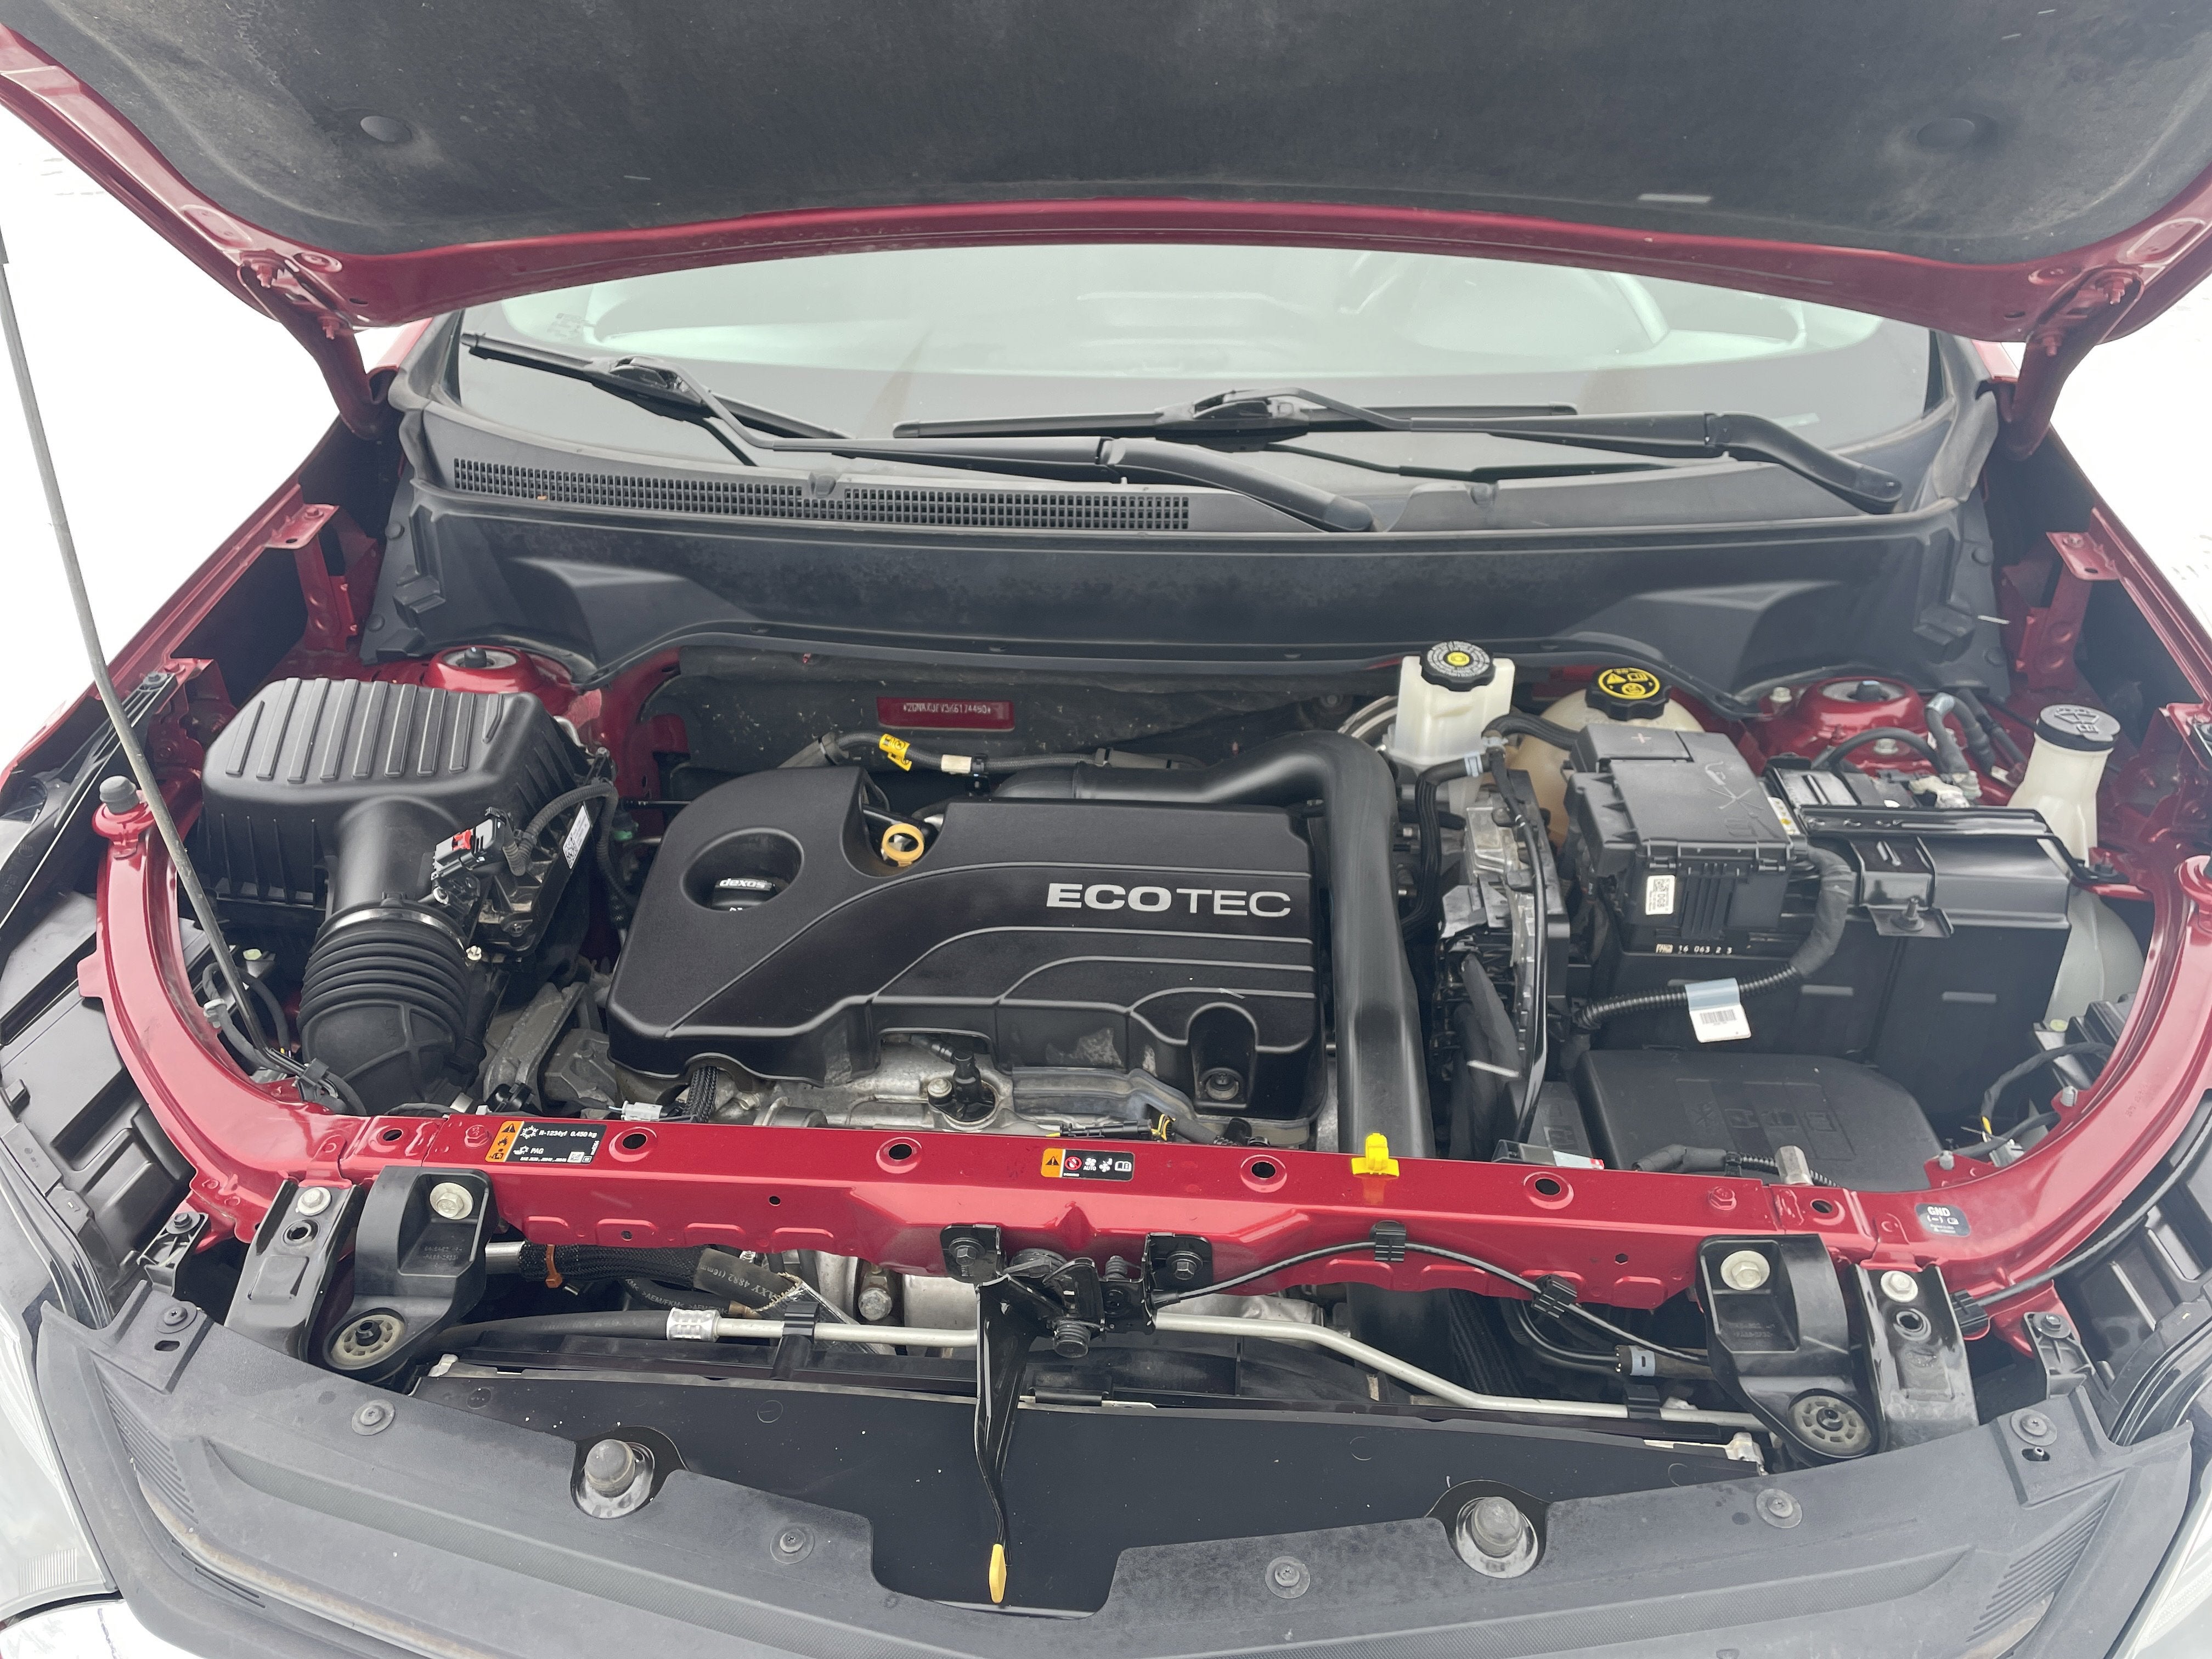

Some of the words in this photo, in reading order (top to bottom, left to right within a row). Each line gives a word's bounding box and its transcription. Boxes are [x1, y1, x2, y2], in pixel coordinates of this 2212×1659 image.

[719, 878, 766, 889] dexos
[1046, 882, 1291, 918] ECOTEC
[1927, 1206, 1951, 1217] GND
[727, 1273, 751, 1288] 4882
